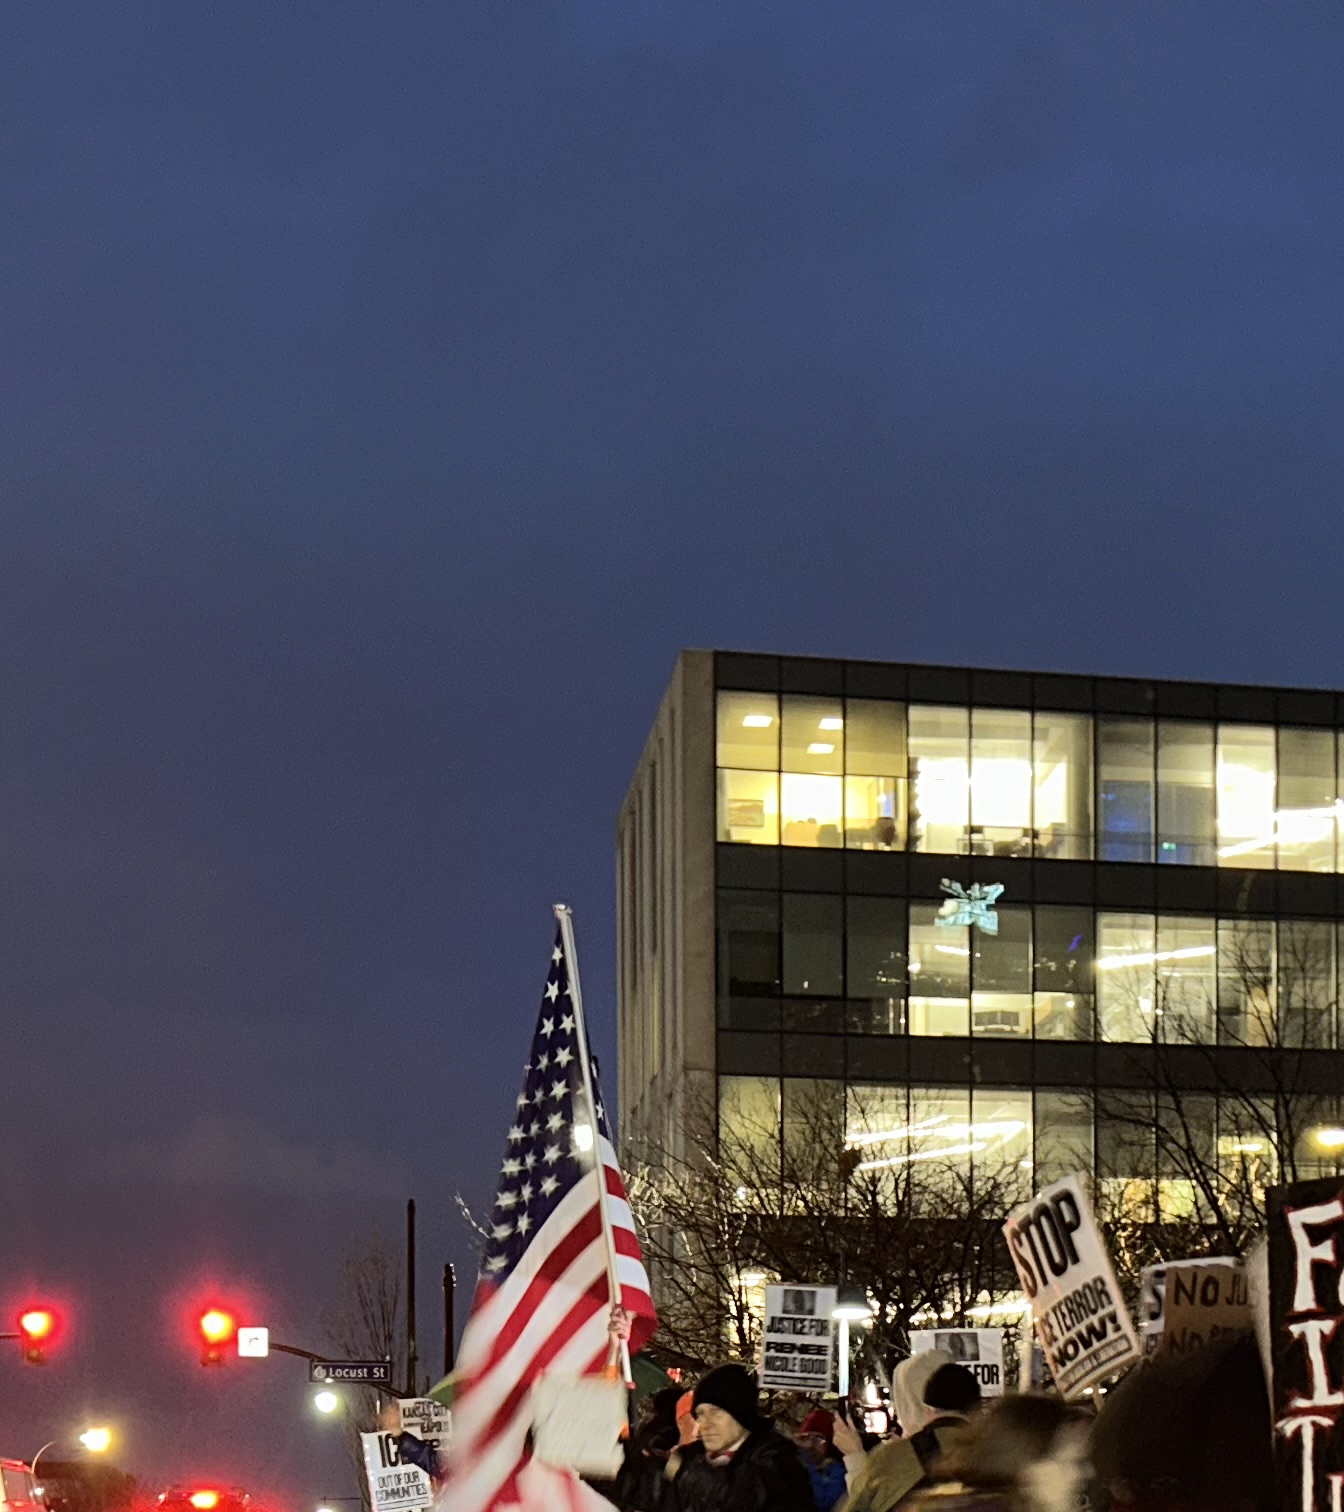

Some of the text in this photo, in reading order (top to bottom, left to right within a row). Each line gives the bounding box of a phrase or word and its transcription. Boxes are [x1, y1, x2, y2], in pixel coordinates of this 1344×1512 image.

[1009, 1188, 1081, 1299] STOP
[1174, 1271, 1220, 1307] NO
[1051, 1274, 1114, 1336] TERROR
[767, 1315, 830, 1337] JUSTICE FOR
[765, 1341, 829, 1356] RENEE
[1051, 1309, 1122, 1373] NOW!
[329, 1366, 385, 1378] Locust St
[974, 1363, 1000, 1385] FOR
[375, 1482, 428, 1503] COMMUNITIES
[378, 1475, 395, 1489] OUT
